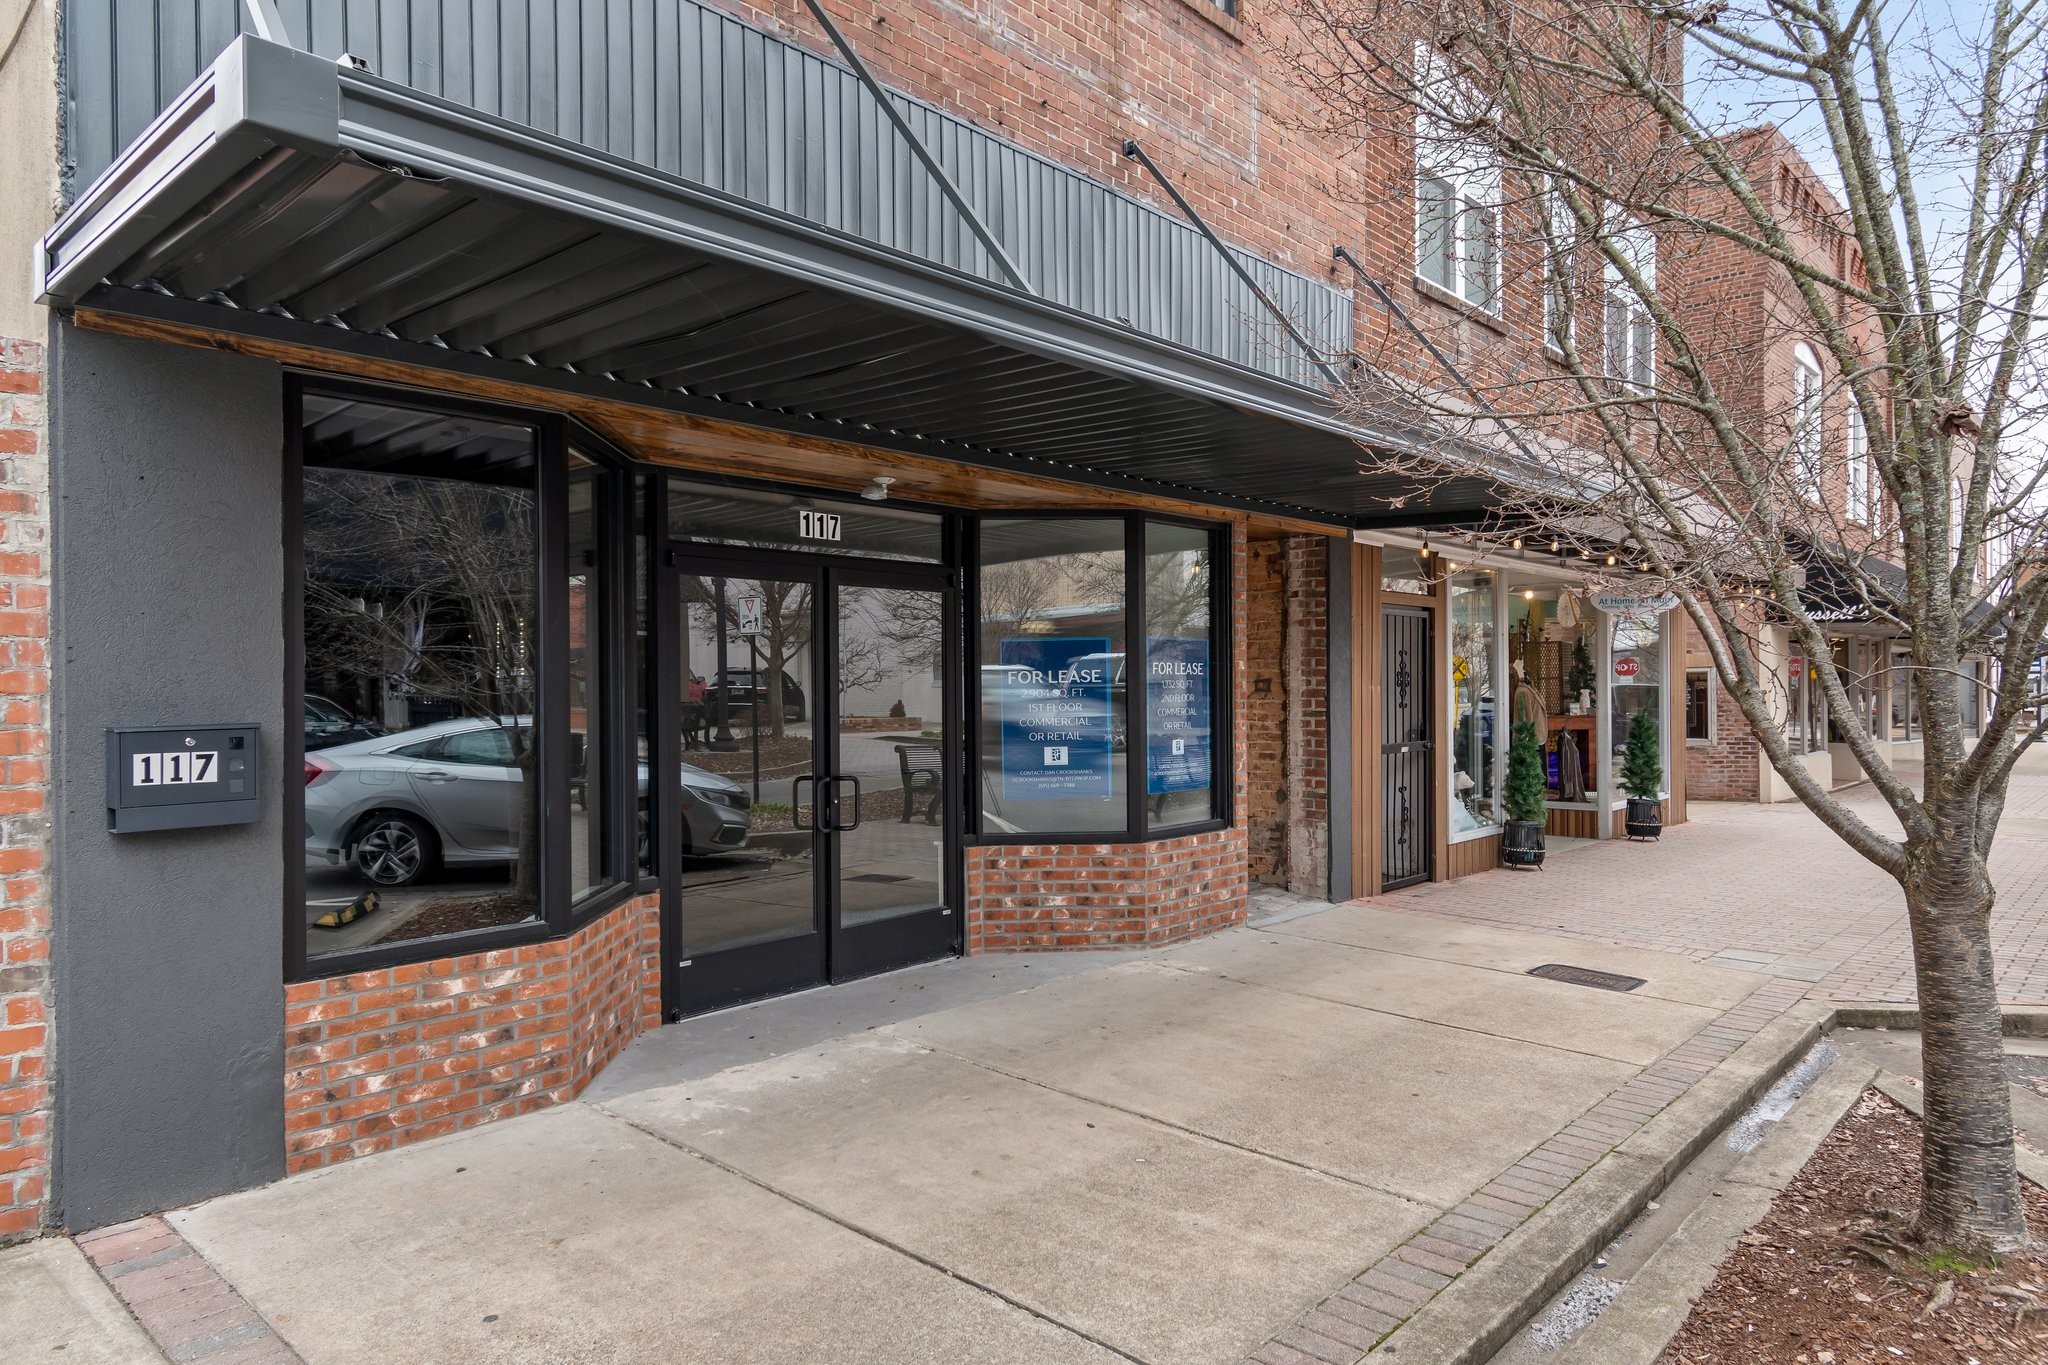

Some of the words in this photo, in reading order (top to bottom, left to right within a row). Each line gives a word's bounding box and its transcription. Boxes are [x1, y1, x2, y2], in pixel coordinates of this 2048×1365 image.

[803, 513, 839, 539] 117
[1611, 597, 1635, 605] Home
[1152, 662, 1173, 675] FOR
[1174, 662, 1204, 675] LEASE
[1008, 670, 1043, 684] FOR
[1048, 669, 1102, 683] LEASE
[1021, 689, 1051, 699] 2,904
[1052, 689, 1070, 698] SQ.
[1072, 688, 1086, 697] FT.
[1161, 694, 1174, 703] 2ND
[1175, 693, 1195, 702] FLOOR
[1028, 703, 1044, 713] 1ST
[1046, 703, 1083, 712] FLOOR
[1157, 707, 1198, 716] COMMERCIAL
[1019, 717, 1092, 727] COMMERCIAL
[1163, 721, 1173, 730] OR
[1173, 721, 1193, 730] RETAIL
[1028, 732, 1045, 741] OR
[1047, 731, 1083, 741] RETAIL
[141, 753, 215, 784] 117
